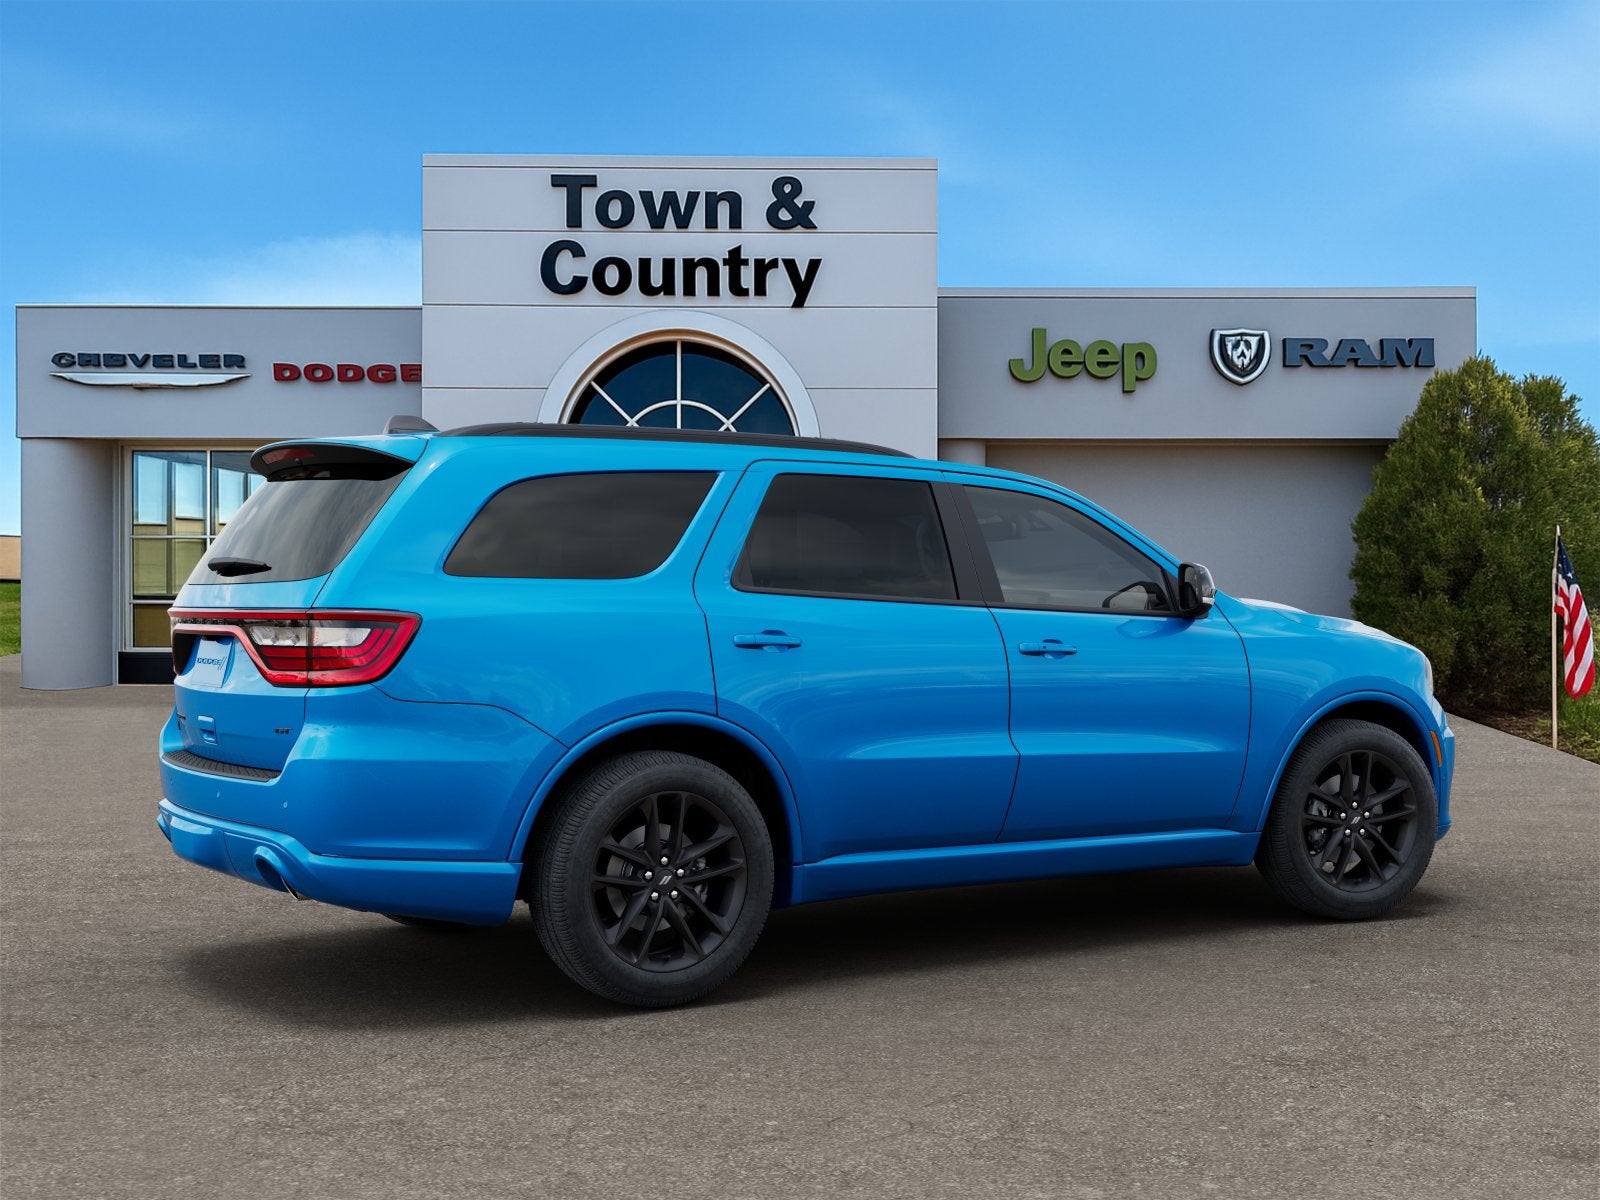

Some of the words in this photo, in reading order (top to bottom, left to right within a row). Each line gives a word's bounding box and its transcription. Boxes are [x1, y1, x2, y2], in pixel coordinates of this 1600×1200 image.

[550, 174, 742, 229] Town
[766, 176, 818, 230] &
[540, 239, 823, 308] Country
[273, 363, 422, 383] DODGE
[1008, 328, 1157, 392] Jeep
[1282, 337, 1435, 368] RAM
